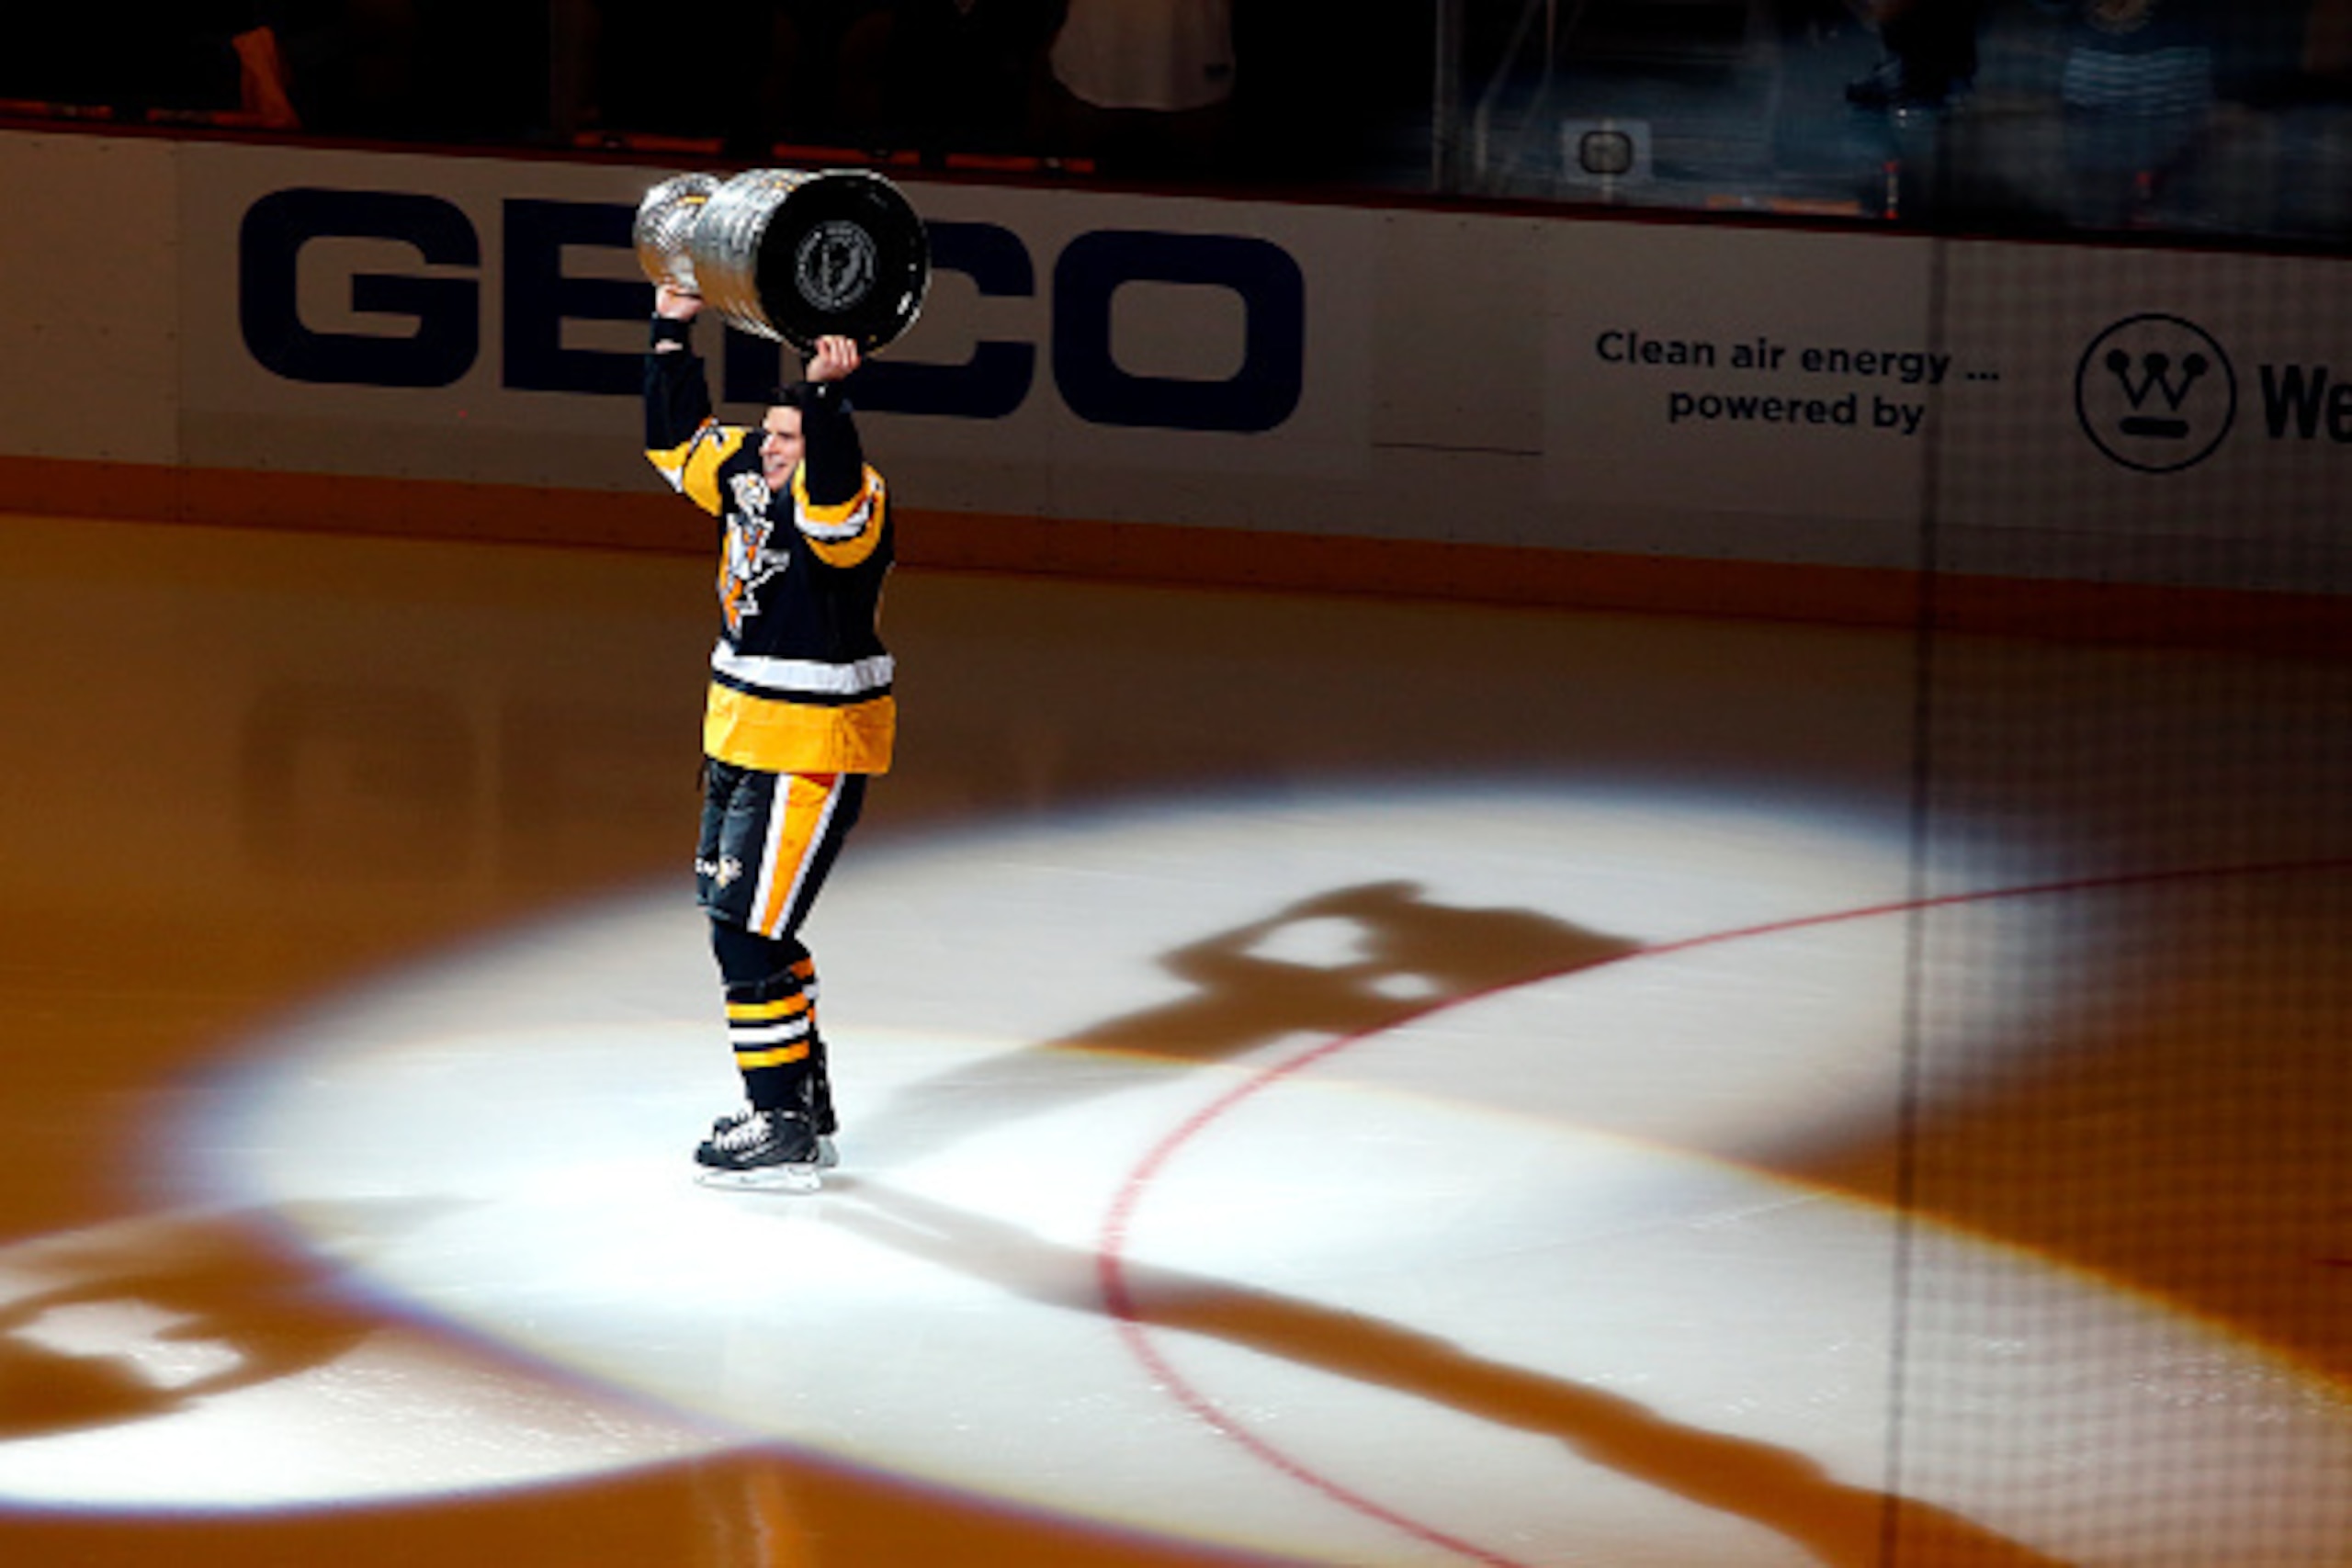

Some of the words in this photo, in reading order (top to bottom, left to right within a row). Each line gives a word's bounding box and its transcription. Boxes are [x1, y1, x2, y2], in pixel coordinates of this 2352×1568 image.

[1596, 331, 1715, 367] Clean
[1730, 336, 1786, 370] air
[1801, 346, 1952, 385] energy
[1668, 391, 1858, 424] powered
[1872, 396, 1926, 435] by
